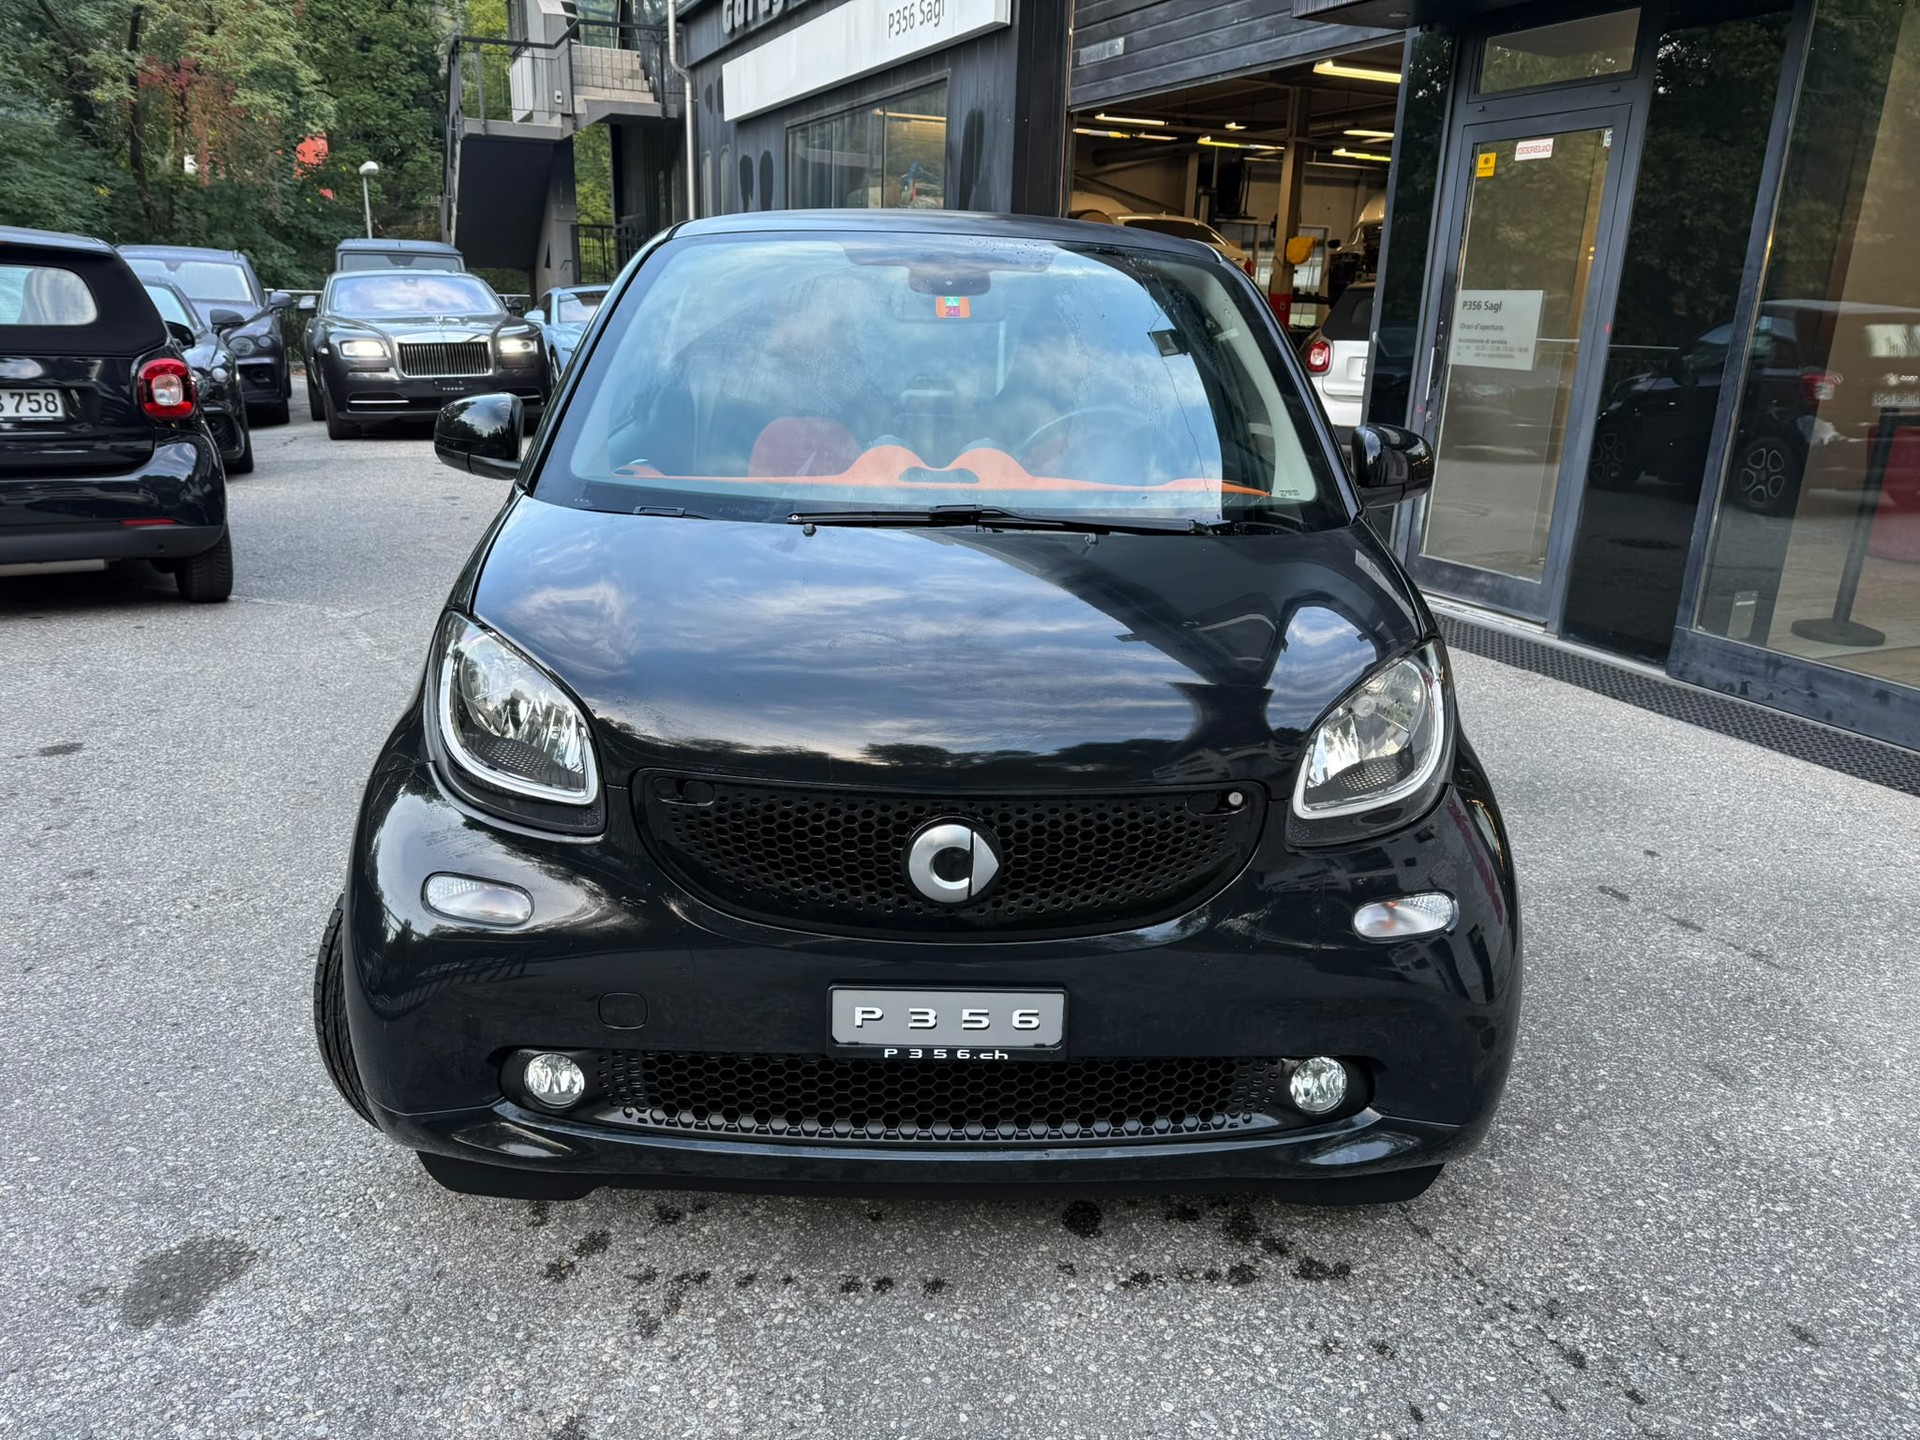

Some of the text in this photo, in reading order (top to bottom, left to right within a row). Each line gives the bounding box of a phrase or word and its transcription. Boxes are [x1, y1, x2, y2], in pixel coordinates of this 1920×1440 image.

[888, 0, 945, 39] P356 Sagl
[1462, 300, 1503, 313] P356 Sagl
[1459, 322, 1473, 330] Orari
